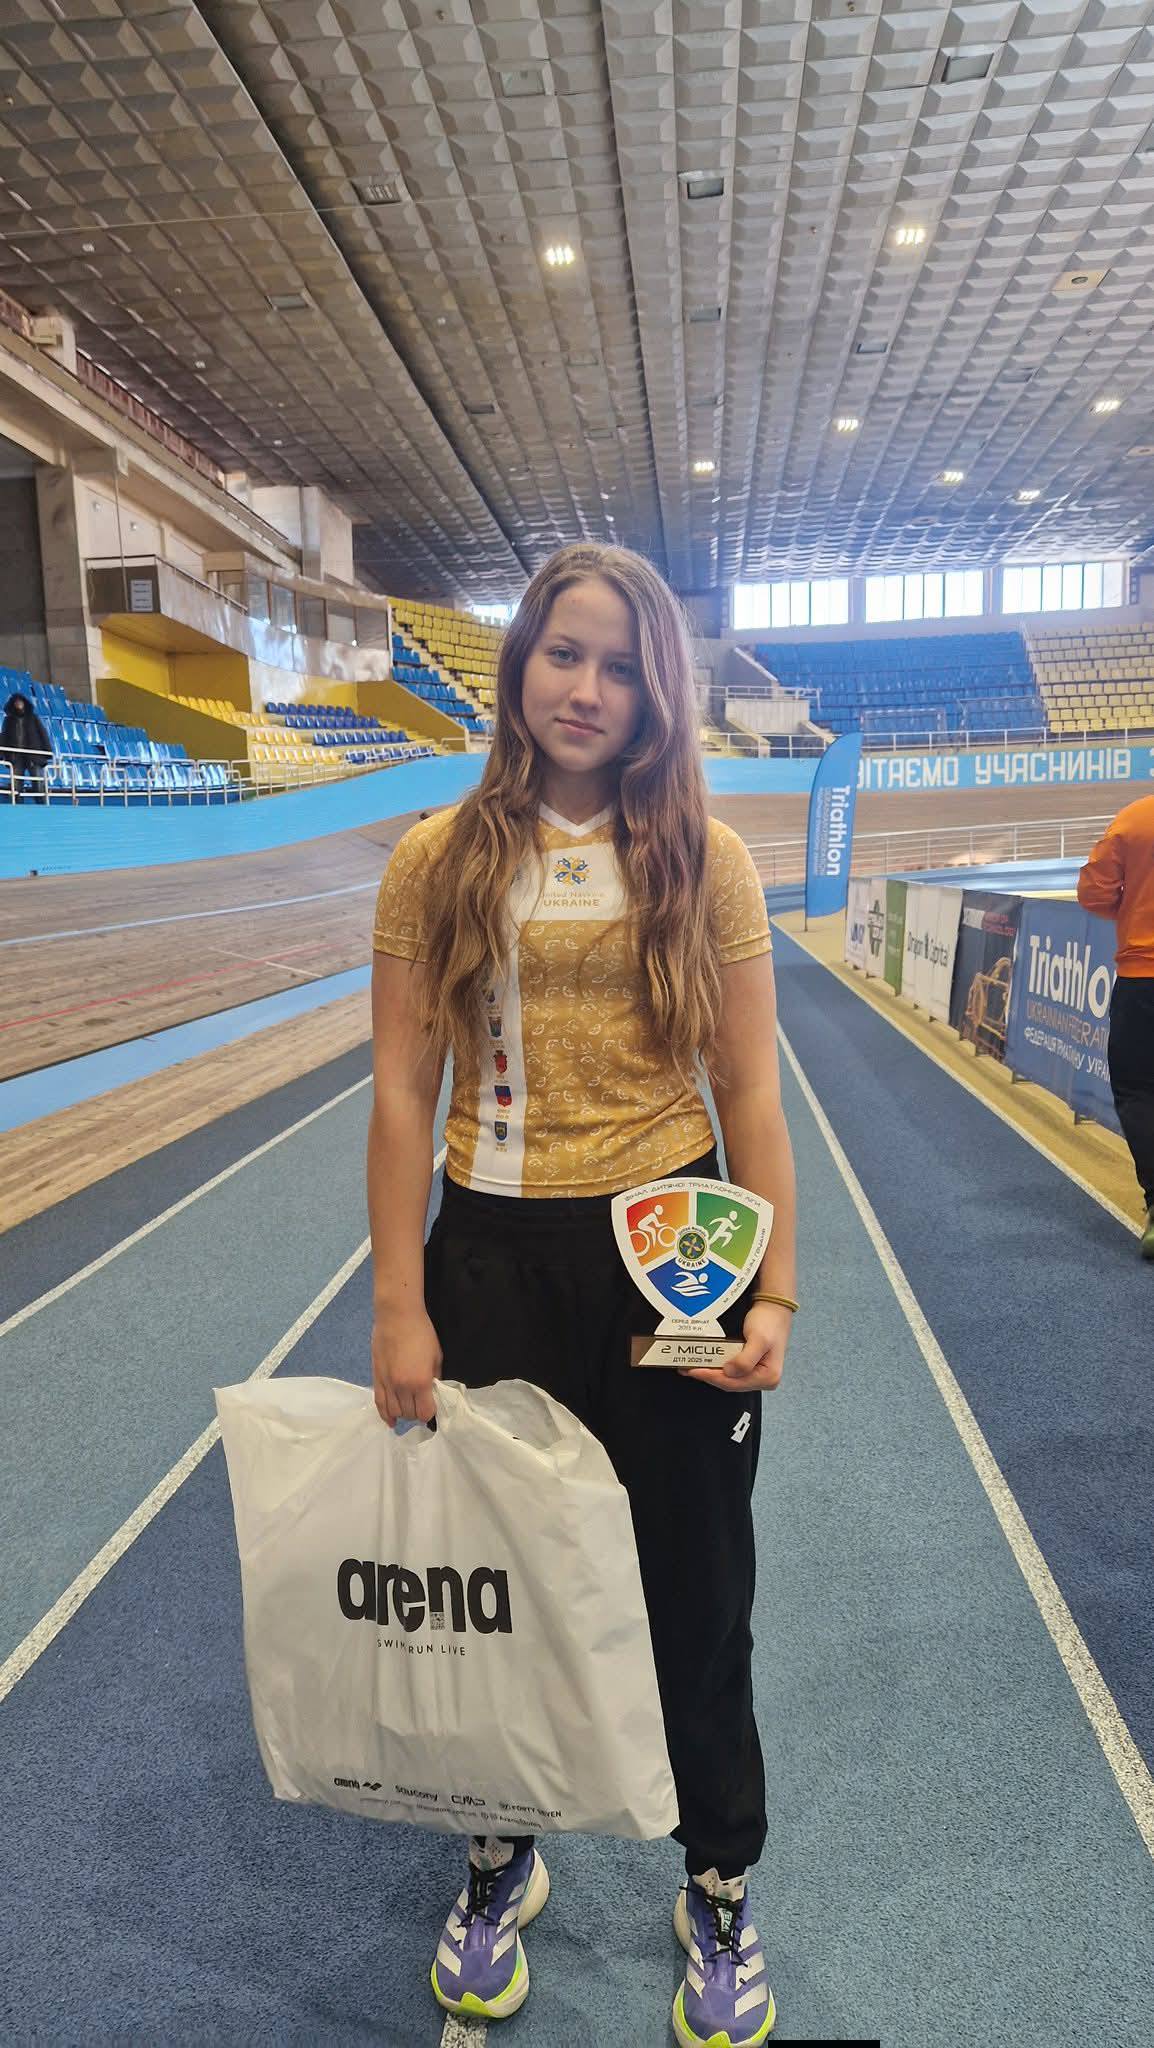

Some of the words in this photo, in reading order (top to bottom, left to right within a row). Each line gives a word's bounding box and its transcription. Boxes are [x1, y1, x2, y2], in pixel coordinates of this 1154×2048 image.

[826, 785, 851, 876] Triathlon
[543, 898, 600, 907] UKRAINE
[1028, 935, 1117, 1018] Triathlo
[678, 1257, 706, 1268] UKRAINE
[661, 1345, 671, 1354] 2
[678, 1345, 725, 1356] МІСЦЕ
[337, 1558, 513, 1634] arena
[408, 1644, 433, 1655] RUN
[441, 1645, 466, 1656] LIVE
